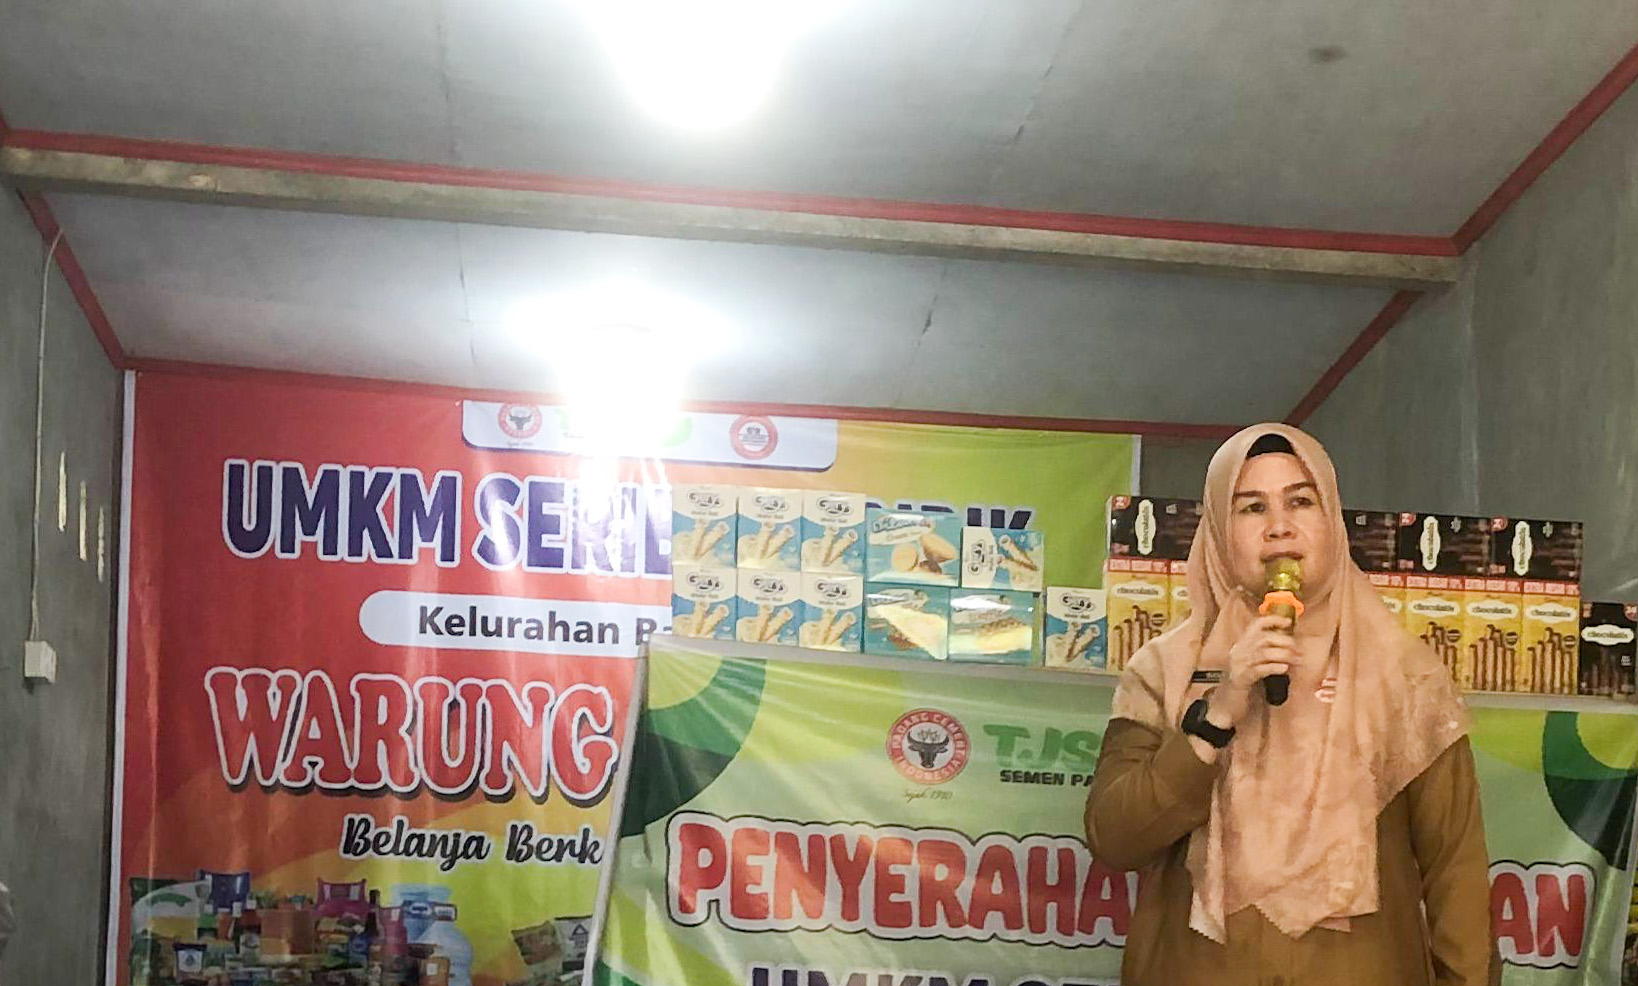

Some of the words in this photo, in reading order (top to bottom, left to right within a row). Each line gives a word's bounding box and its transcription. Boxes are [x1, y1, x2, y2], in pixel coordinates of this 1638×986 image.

[224, 460, 461, 566] UMKM
[417, 605, 620, 646] Kelurahan
[204, 667, 619, 803] WARUNG
[1000, 770, 1065, 786] SEMEN
[343, 816, 490, 870] Belanja
